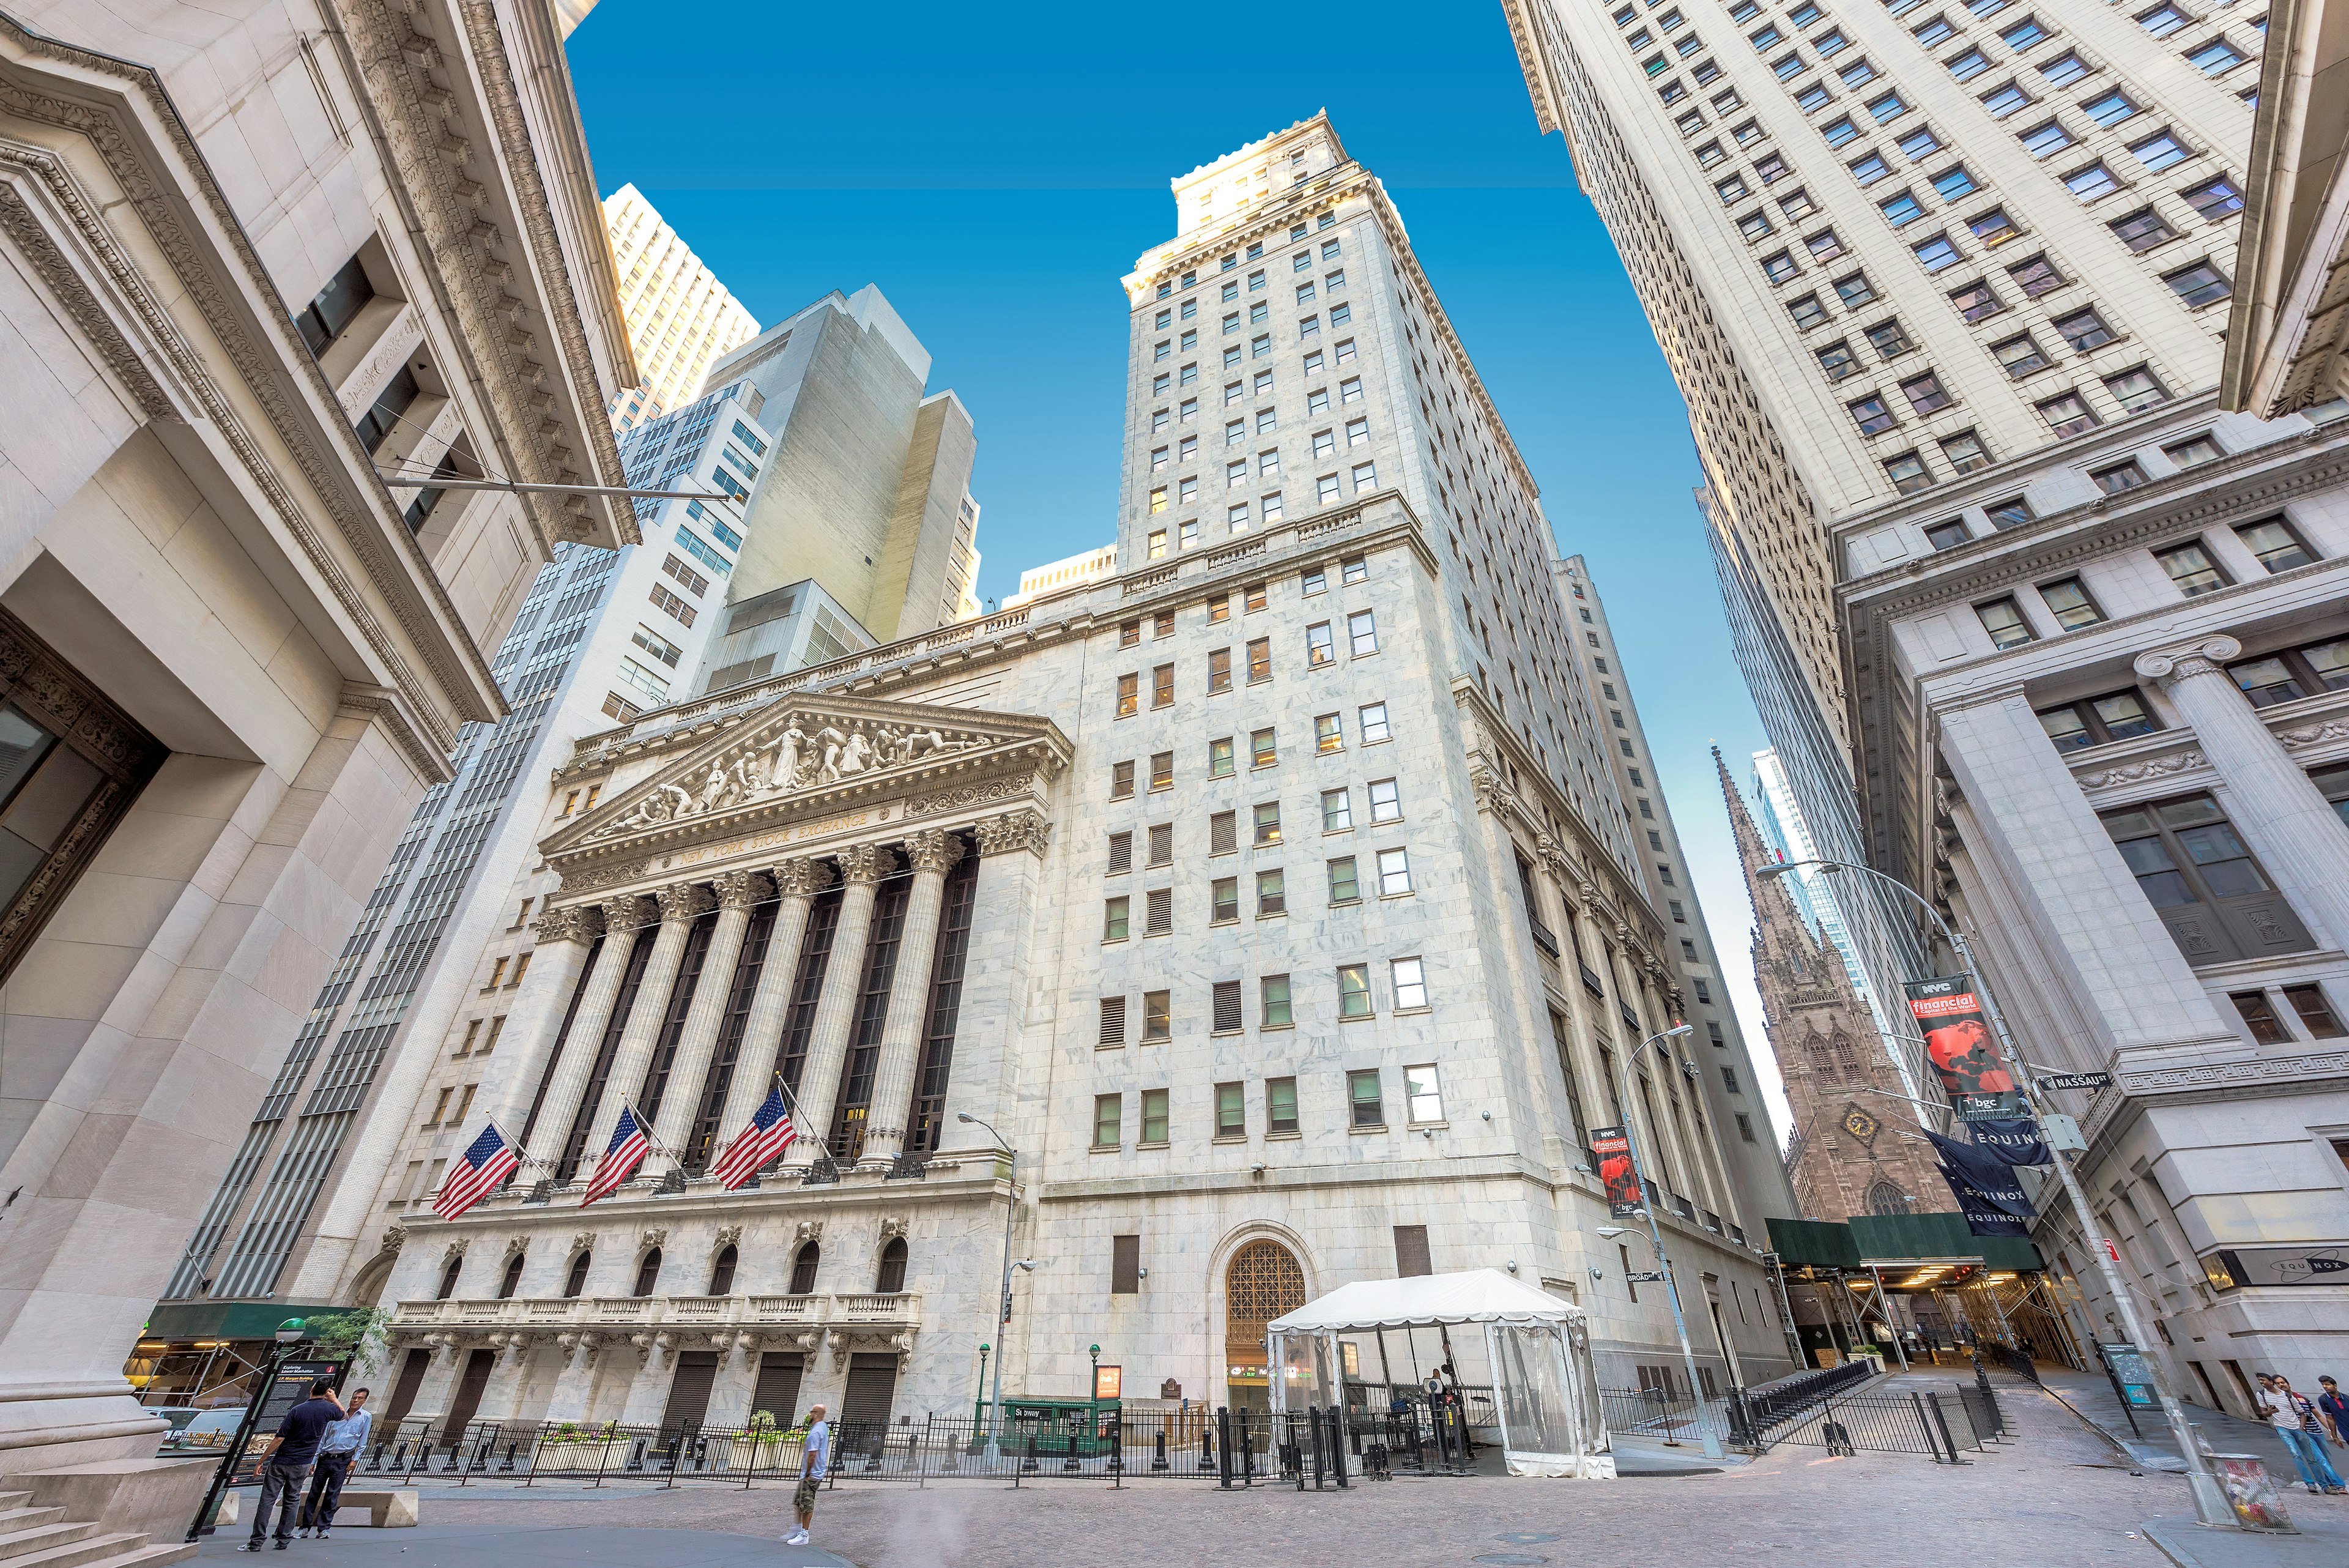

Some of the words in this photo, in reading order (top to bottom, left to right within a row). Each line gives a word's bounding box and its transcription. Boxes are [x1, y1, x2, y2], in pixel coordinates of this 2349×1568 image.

[680, 849, 707, 864] NEW
[713, 841, 745, 857] YORK
[752, 831, 791, 849] STOCK
[798, 812, 868, 839] EXCHANGE
[1922, 983, 1951, 994] NYC
[1913, 995, 1973, 1013] financial
[2055, 1076, 2099, 1088] NASSAU
[1975, 1098, 1997, 1109] bgc
[1595, 1139, 1626, 1150] financial
[1964, 1187, 2024, 1201] EQUINOX
[1967, 1214, 2022, 1223] EQUINOX
[2280, 1261, 2342, 1270] EQUINOX
